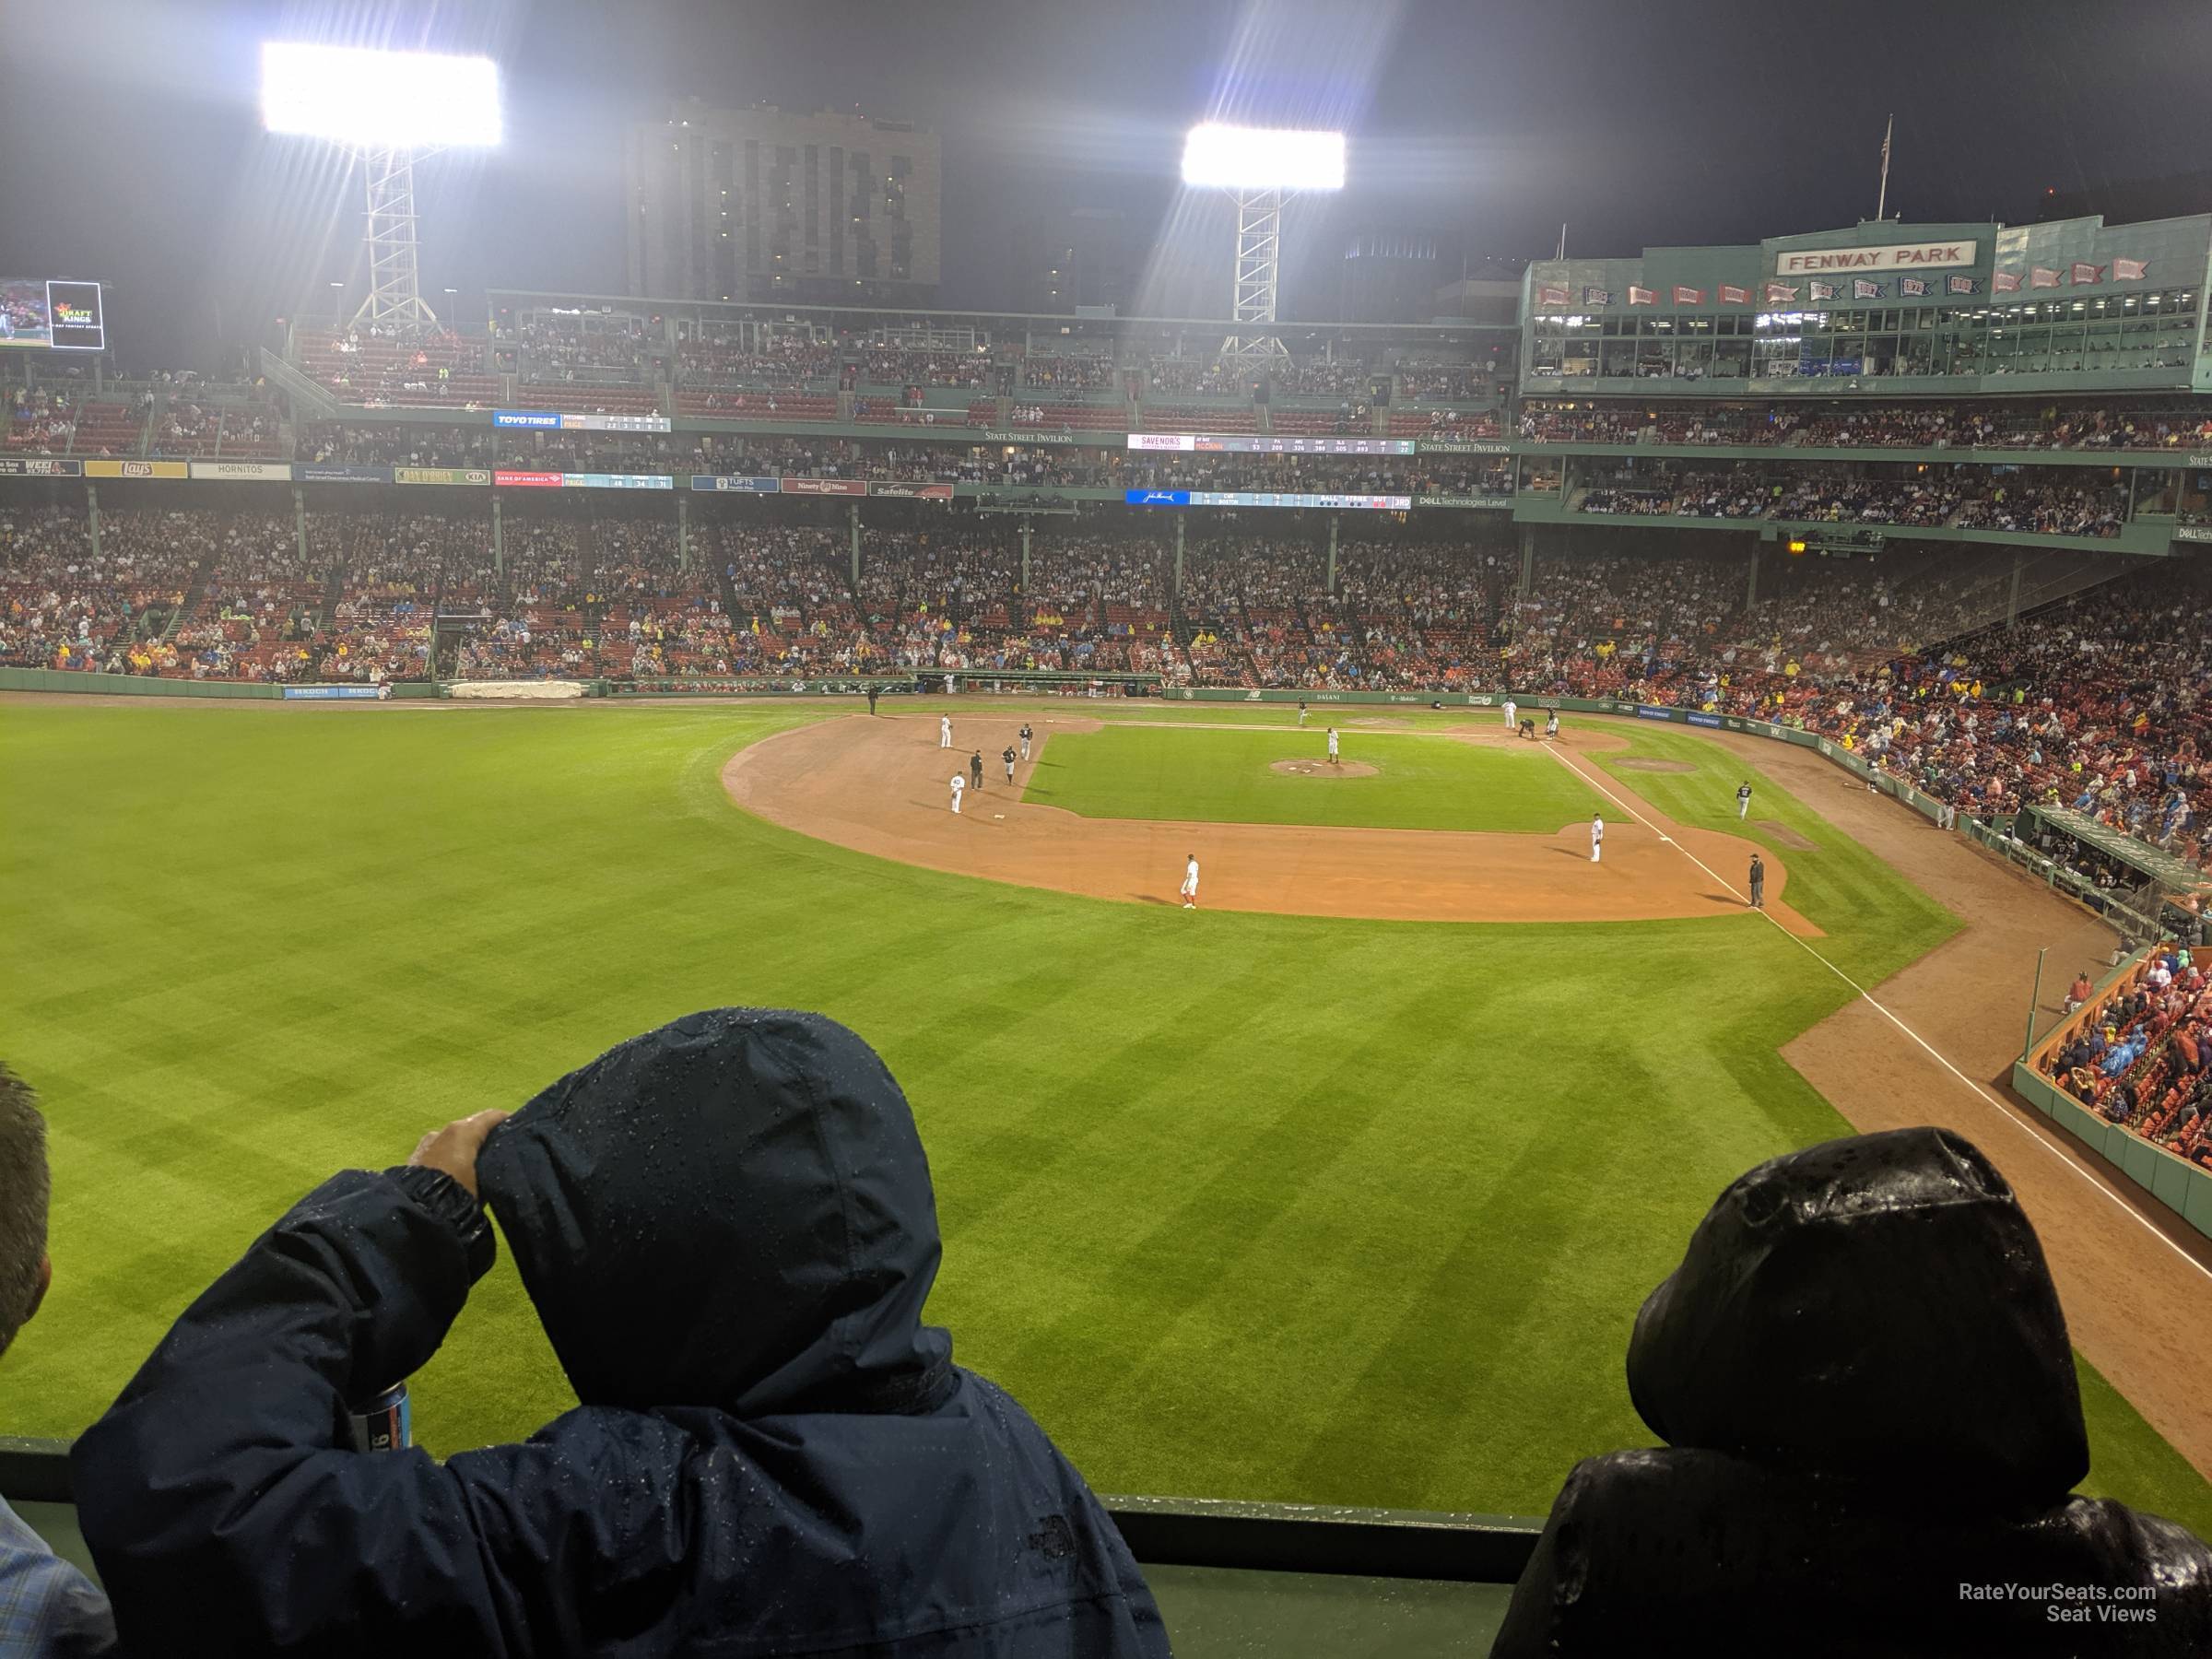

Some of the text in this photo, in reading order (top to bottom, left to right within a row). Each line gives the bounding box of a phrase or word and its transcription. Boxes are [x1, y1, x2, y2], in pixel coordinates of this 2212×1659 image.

[1788, 246, 1961, 270] FENWAY PARK
[499, 416, 557, 425] TOYO TIRES
[985, 431, 1073, 442] STATE STREET PAVILION
[1142, 436, 1181, 445] SAVENOR'S
[1420, 442, 1511, 453] STATE STREET PAVILION
[2189, 454, 2209, 465] STATE
[218, 465, 265, 473] HORNITOS
[797, 482, 819, 490] Ninety
[877, 488, 914, 496] Safelite
[1394, 498, 1410, 506] 3RD
[1488, 499, 1506, 507] Level
